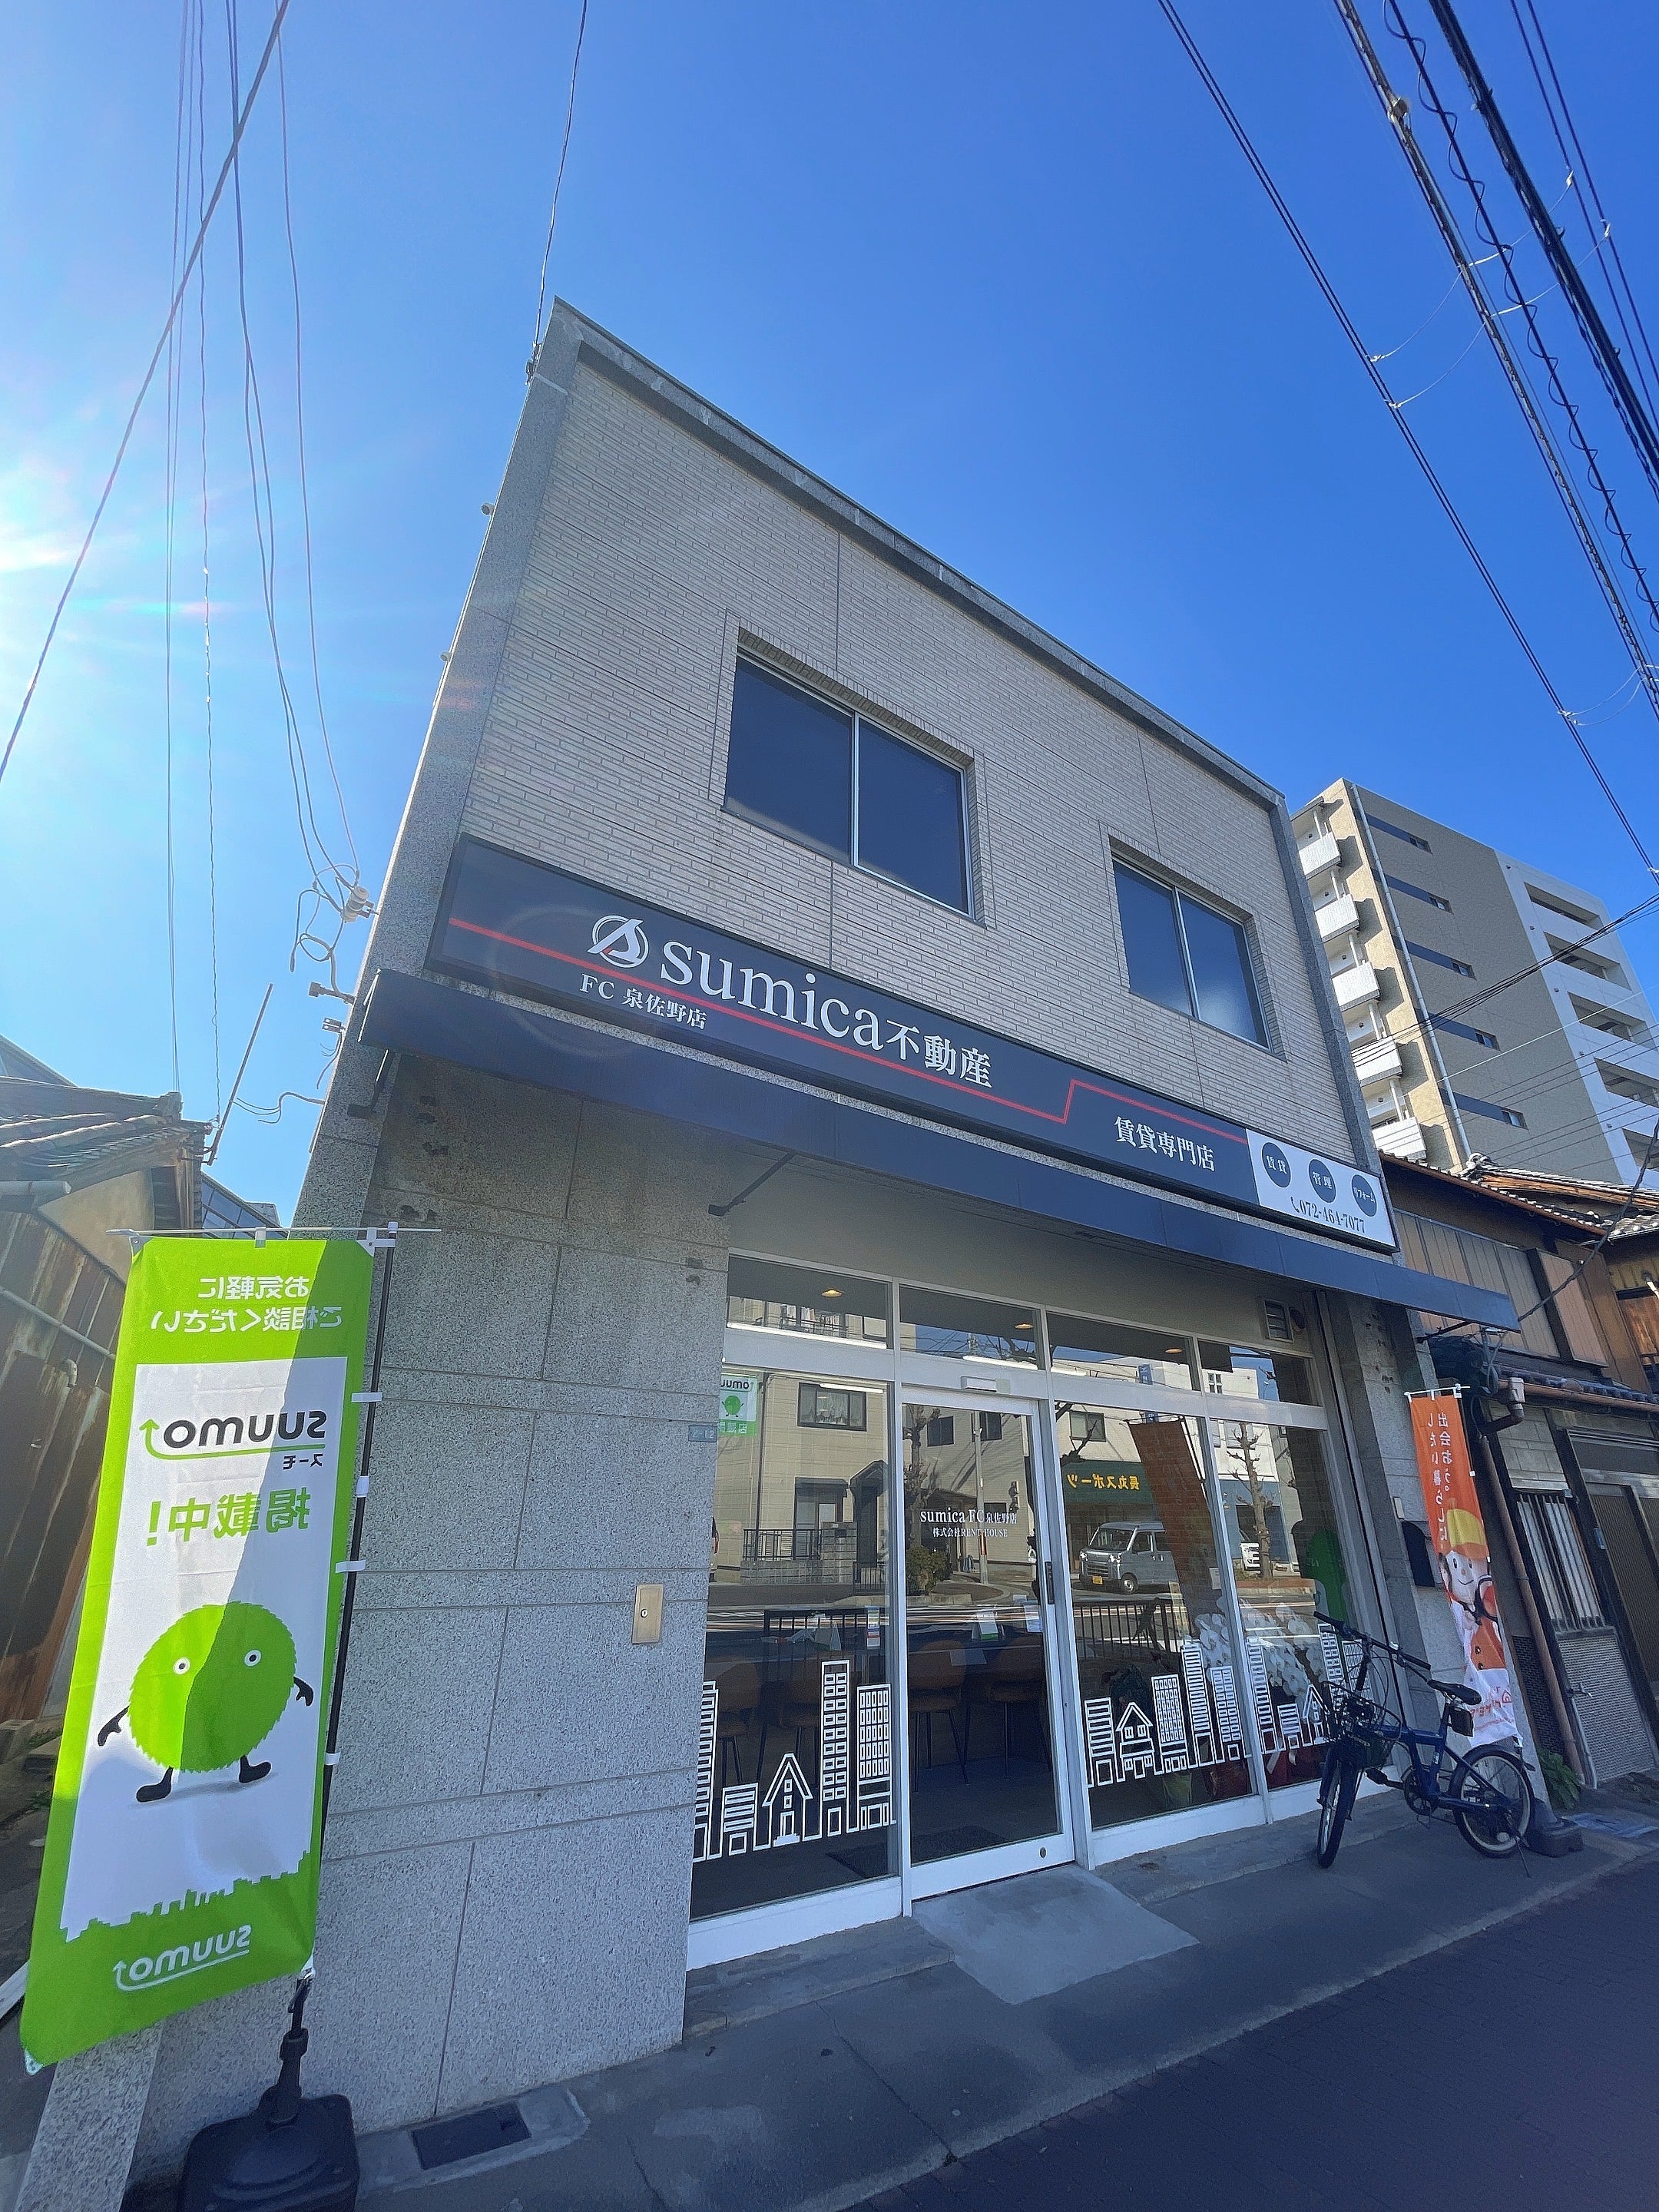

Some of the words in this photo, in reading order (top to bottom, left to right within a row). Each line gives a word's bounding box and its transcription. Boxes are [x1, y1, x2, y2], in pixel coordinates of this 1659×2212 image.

[580, 973, 615, 1001] FC
[621, 987, 708, 1031] 泉佐野店
[1114, 1115, 1216, 1172] 賃貸専門店
[1299, 1200, 1366, 1233] 072-464-7077
[920, 1506, 966, 1523] sumica
